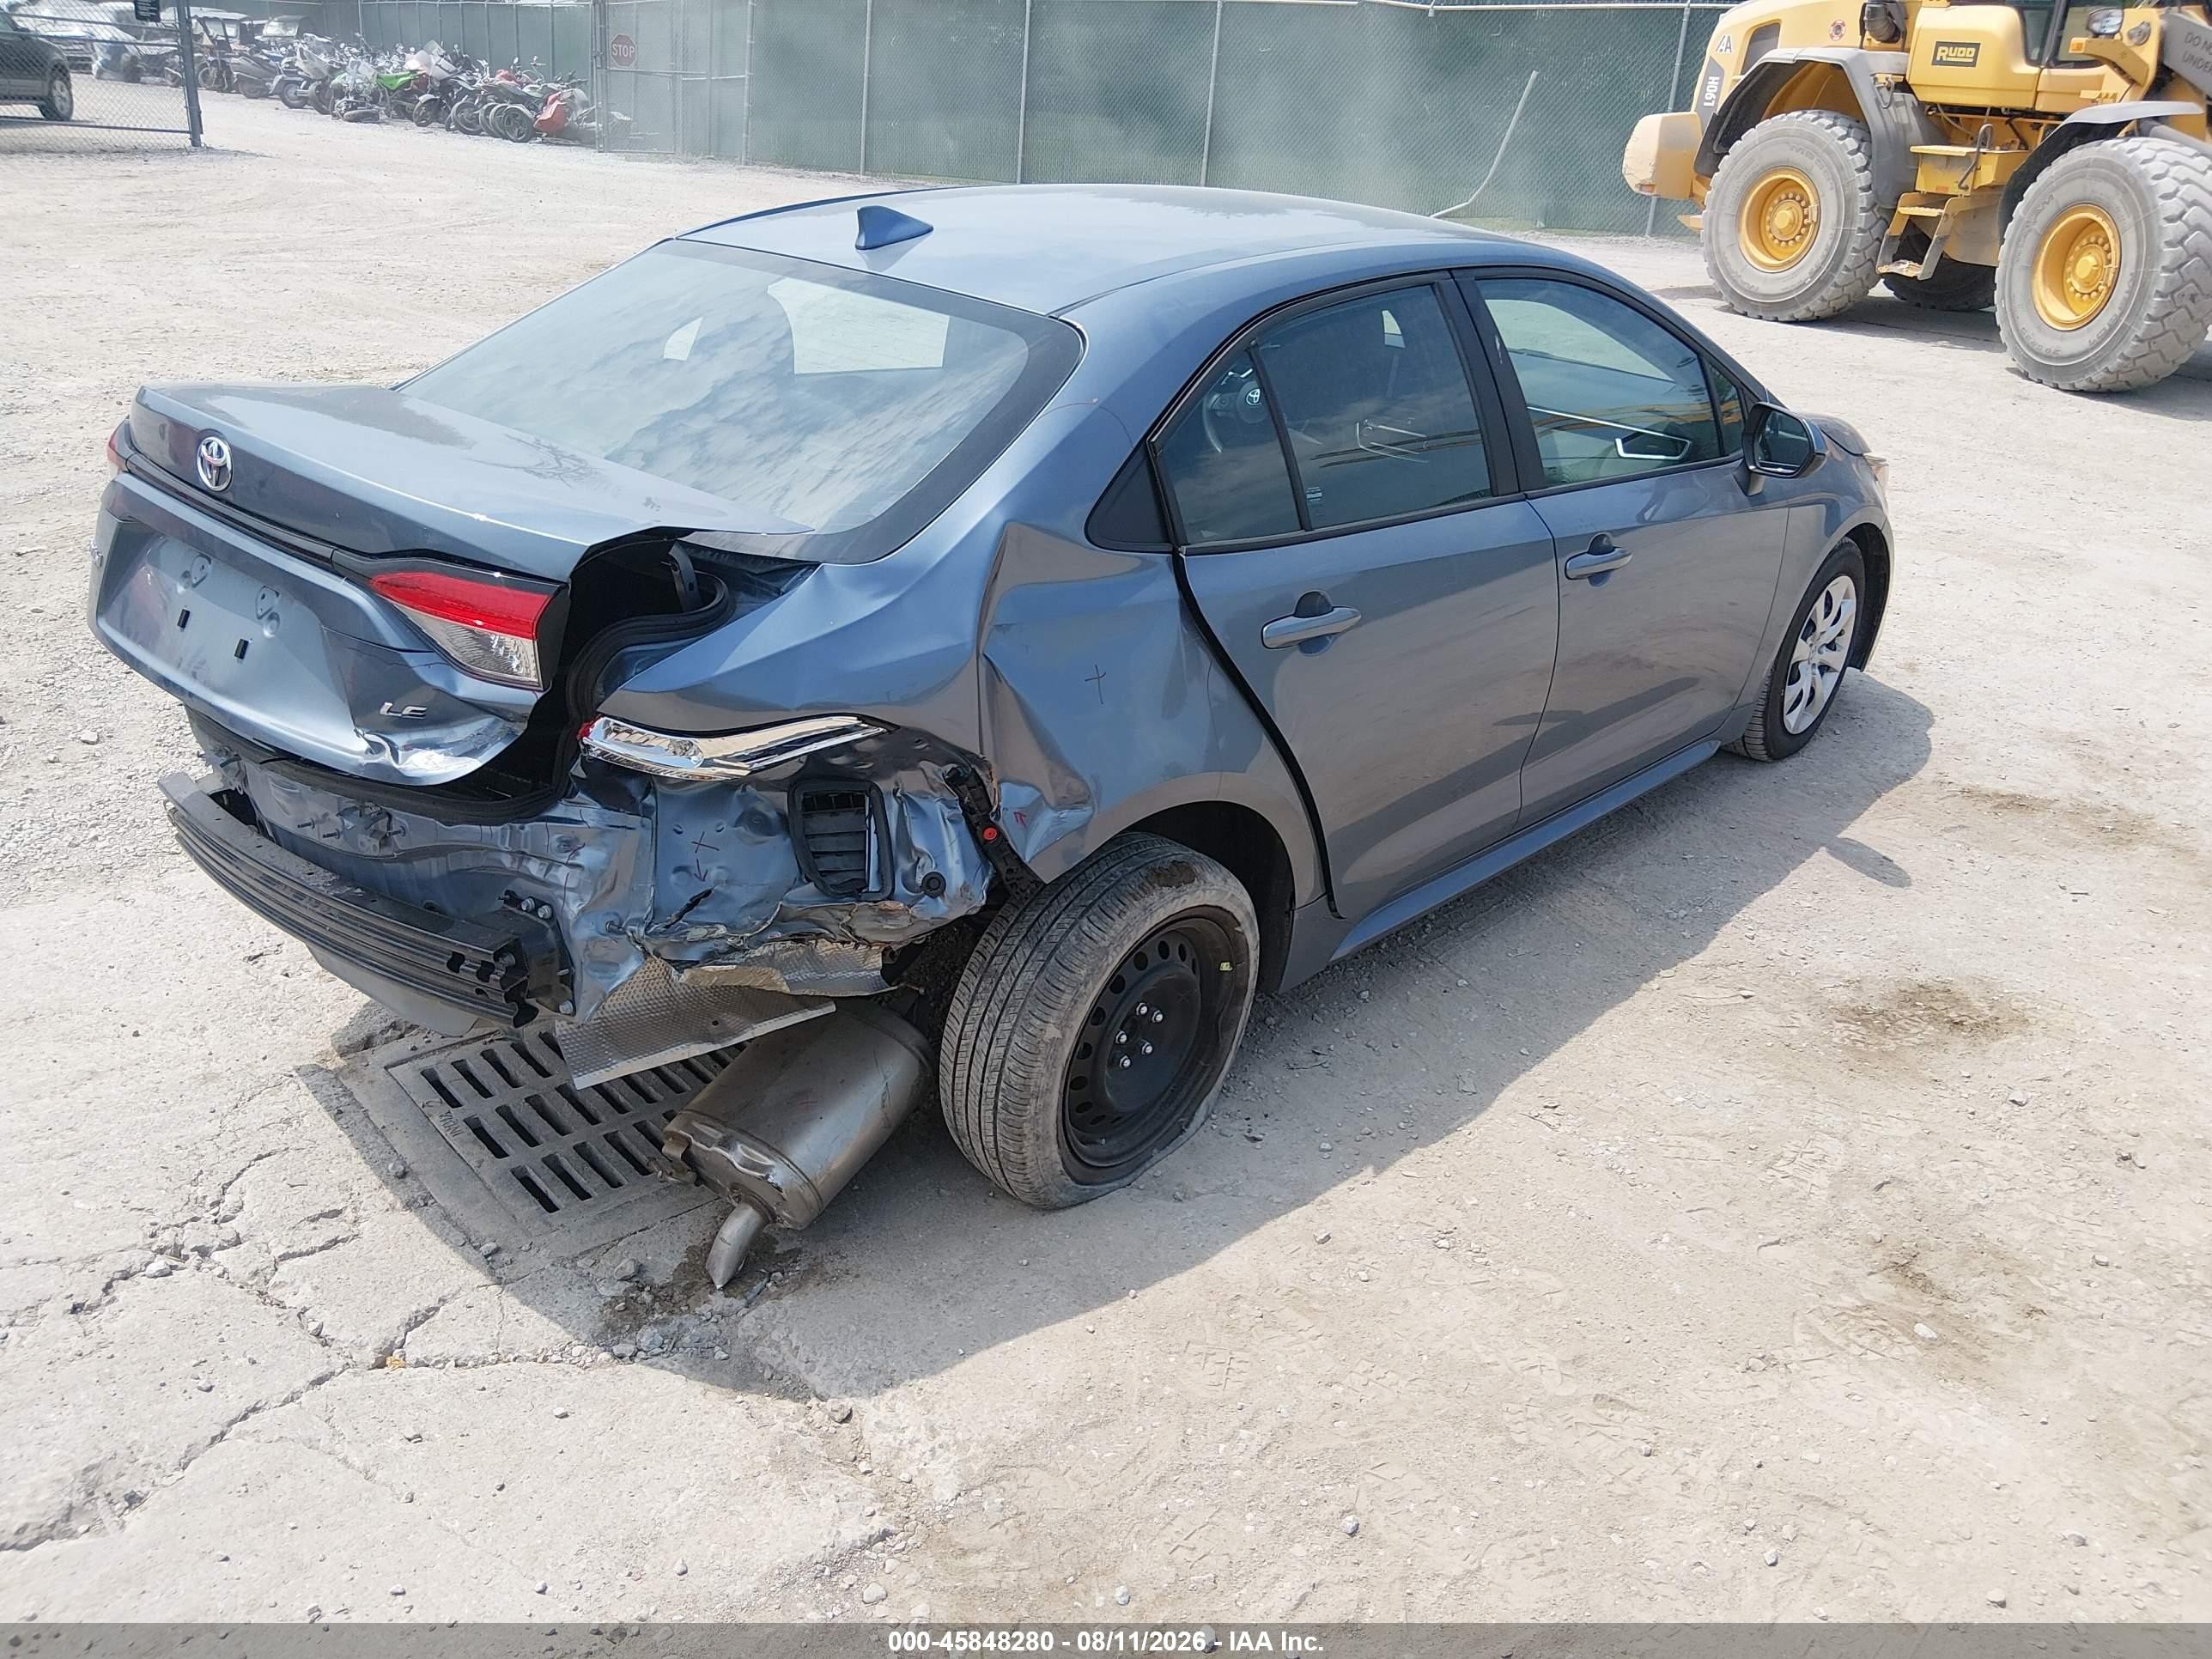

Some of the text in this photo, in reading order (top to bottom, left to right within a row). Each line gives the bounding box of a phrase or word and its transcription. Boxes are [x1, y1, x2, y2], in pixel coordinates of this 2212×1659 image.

[2185, 32, 2201, 46] DO
[611, 44, 635, 58] STOP
[1703, 76, 1720, 106] L90H
[380, 702, 428, 720] LE
